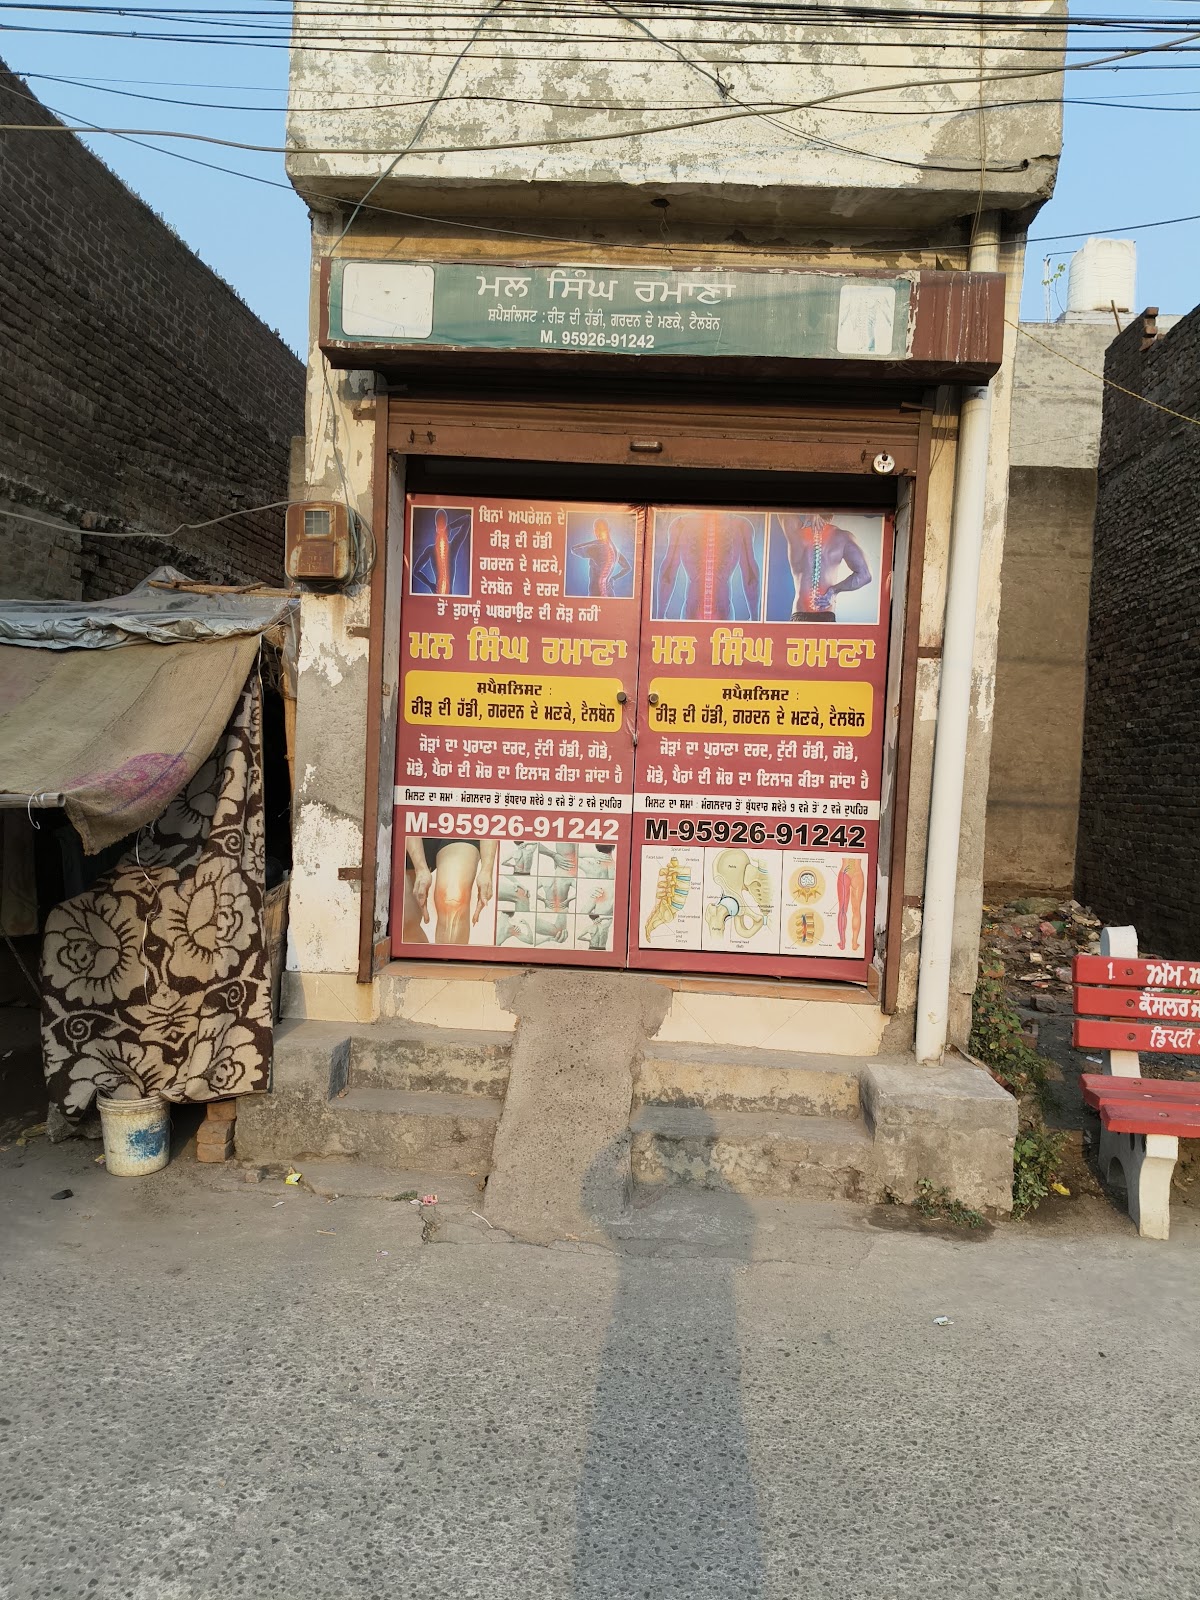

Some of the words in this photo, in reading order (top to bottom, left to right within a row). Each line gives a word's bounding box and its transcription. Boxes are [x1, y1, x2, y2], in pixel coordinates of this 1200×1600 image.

[476, 275, 531, 297] ਮਲ
[547, 269, 618, 301] ਸਿੰਘ
[634, 280, 736, 304] ਰਮਾਣਾ
[547, 306, 565, 324] ਰੀੜ
[569, 307, 581, 325] ਦੀ
[585, 308, 606, 329] ਹੱਡੀ,
[611, 314, 641, 328] ਗਰਦਨ
[645, 310, 654, 328] ਦੇ
[657, 311, 685, 332] ਮਣਕੇ,
[689, 311, 721, 330] ਟੈਲਬੋਨ
[540, 330, 557, 344] M.
[562, 331, 655, 349] 95926-91242
[479, 505, 504, 523] ਬਿਨਾਂ
[508, 506, 552, 526] ਅਪਰੇਸ਼ਨ
[557, 508, 565, 525] ਦੇ
[490, 529, 510, 550] ਰੀੜ
[515, 530, 528, 548] ਦੀ
[532, 531, 552, 549] ਹੱਡੀ
[479, 557, 514, 571] ਗਰਦਨ
[519, 554, 527, 572] ਦੇ
[532, 555, 562, 576] ਮਣਕੇ,
[523, 578, 531, 596] ਦੇ
[536, 583, 559, 597] ਦਰਦ
[437, 599, 448, 616] ਤੋਂ
[453, 600, 481, 624] ਤੁਹਾਨੂੰ
[486, 602, 533, 623] ਘਬਰਾਉਣ
[539, 603, 551, 620] ਦੀ
[556, 602, 573, 623] ਲੋੜ
[579, 604, 601, 622] ਨਹੀਂ
[408, 632, 455, 660] ਮਲ
[467, 626, 529, 663] ਸਿੰਘ
[541, 637, 628, 666] ਰਮਾਣਾ
[651, 636, 698, 665] ਮਲ
[710, 627, 774, 667] ਸਿੰਘ
[786, 638, 876, 668] ਰਮਾਣਾ
[411, 696, 433, 718] ਰੀੜ
[438, 697, 451, 716] ਦੀ
[457, 697, 482, 720] ਹੱਡੀ,
[487, 703, 525, 719] ਗਰਦਨ
[530, 700, 539, 719] ਦੇ
[544, 701, 576, 724] ਮਣਕੇ,
[581, 701, 616, 723] ਟੈਲਬੋਨ
[656, 703, 677, 724] ਰੀੜ
[683, 704, 696, 723] ਦੀ
[701, 704, 727, 726] ਹੱਡੀ,
[732, 708, 770, 725] ਗਰਦਨ
[776, 705, 785, 725] ਦੇ
[791, 706, 824, 729] ਮਣਕੇ,
[829, 705, 865, 727] ਟੈਲਬੋਨ
[419, 733, 440, 753] ਜੋੜਾਂ
[445, 739, 458, 752] ਦਾ
[463, 740, 497, 757] ਪੁਰਾਣਾ
[502, 741, 530, 758] ਦਰਦ,
[534, 738, 554, 759] ਟੁੱਟੀ
[559, 739, 583, 760] ਹੱਡੀ,
[588, 740, 612, 761] ਗੋਡੇ,
[660, 736, 681, 757] ਜੋੜਾਂ
[686, 741, 699, 755] ਦਾ
[703, 742, 739, 760] ਪੁਰਾਣਾ
[744, 743, 772, 760] ਦਰਦ,
[777, 739, 797, 761] ਟੁੱਟੀ
[802, 740, 828, 762] ਹੱਡੀ,
[833, 740, 858, 763] ਗੋਡੇ,
[406, 757, 427, 779] ਮੋਡੇ,
[432, 757, 453, 777] ਪੈਰਾਂ
[457, 760, 470, 778] ਦੀ
[497, 765, 510, 779] ਦਾ
[515, 762, 550, 781] ਇਲਾਜ
[555, 764, 580, 782] ਕੀਤਾ
[585, 766, 610, 783] ਜਾਂਦਾ
[614, 764, 623, 784] ਹੈ
[646, 764, 668, 786] ਮੋਡੇ,
[672, 764, 693, 784] ਪੈਰਾਂ
[698, 767, 711, 785] ਦੀ
[738, 772, 752, 786] ਦਾ
[757, 768, 793, 787] ਇਲਾਜ
[798, 769, 825, 788] ਕੀਤਾ
[829, 772, 856, 789] ਜਾਂਦਾ
[860, 769, 869, 790] ਹੈ
[405, 788, 425, 801] ਮਿਲਣ
[428, 792, 437, 802] ਦਾ
[461, 790, 491, 804] ਮੰਗਲਵਾਰ
[494, 791, 502, 804] ਤੋਂ
[530, 793, 544, 806] ਸਵੇਰੇ
[547, 796, 553, 806] 9
[556, 794, 565, 807] ਵਜੇ
[568, 794, 576, 807] ਤੋਂ
[579, 798, 584, 807] 2
[587, 795, 596, 808] ਵਜੇ
[645, 796, 665, 808] ਮਿਲਣ
[669, 799, 677, 809] ਦਾ
[701, 798, 732, 810] ਮੰਗਲਵਾਰ
[771, 800, 787, 813] ਸਵੇਰੇ
[790, 803, 795, 813] 9
[799, 801, 809, 813] ਵਜੇ
[822, 804, 828, 814] 2
[831, 801, 841, 815] ਵਜੇ
[405, 811, 620, 841] M-95926-91242
[645, 818, 866, 848] M-95926-91242
[1139, 992, 1191, 1017] ਕੌਂਸਲਰ
[1150, 1026, 1196, 1049] ਡਿਪਟੀ
